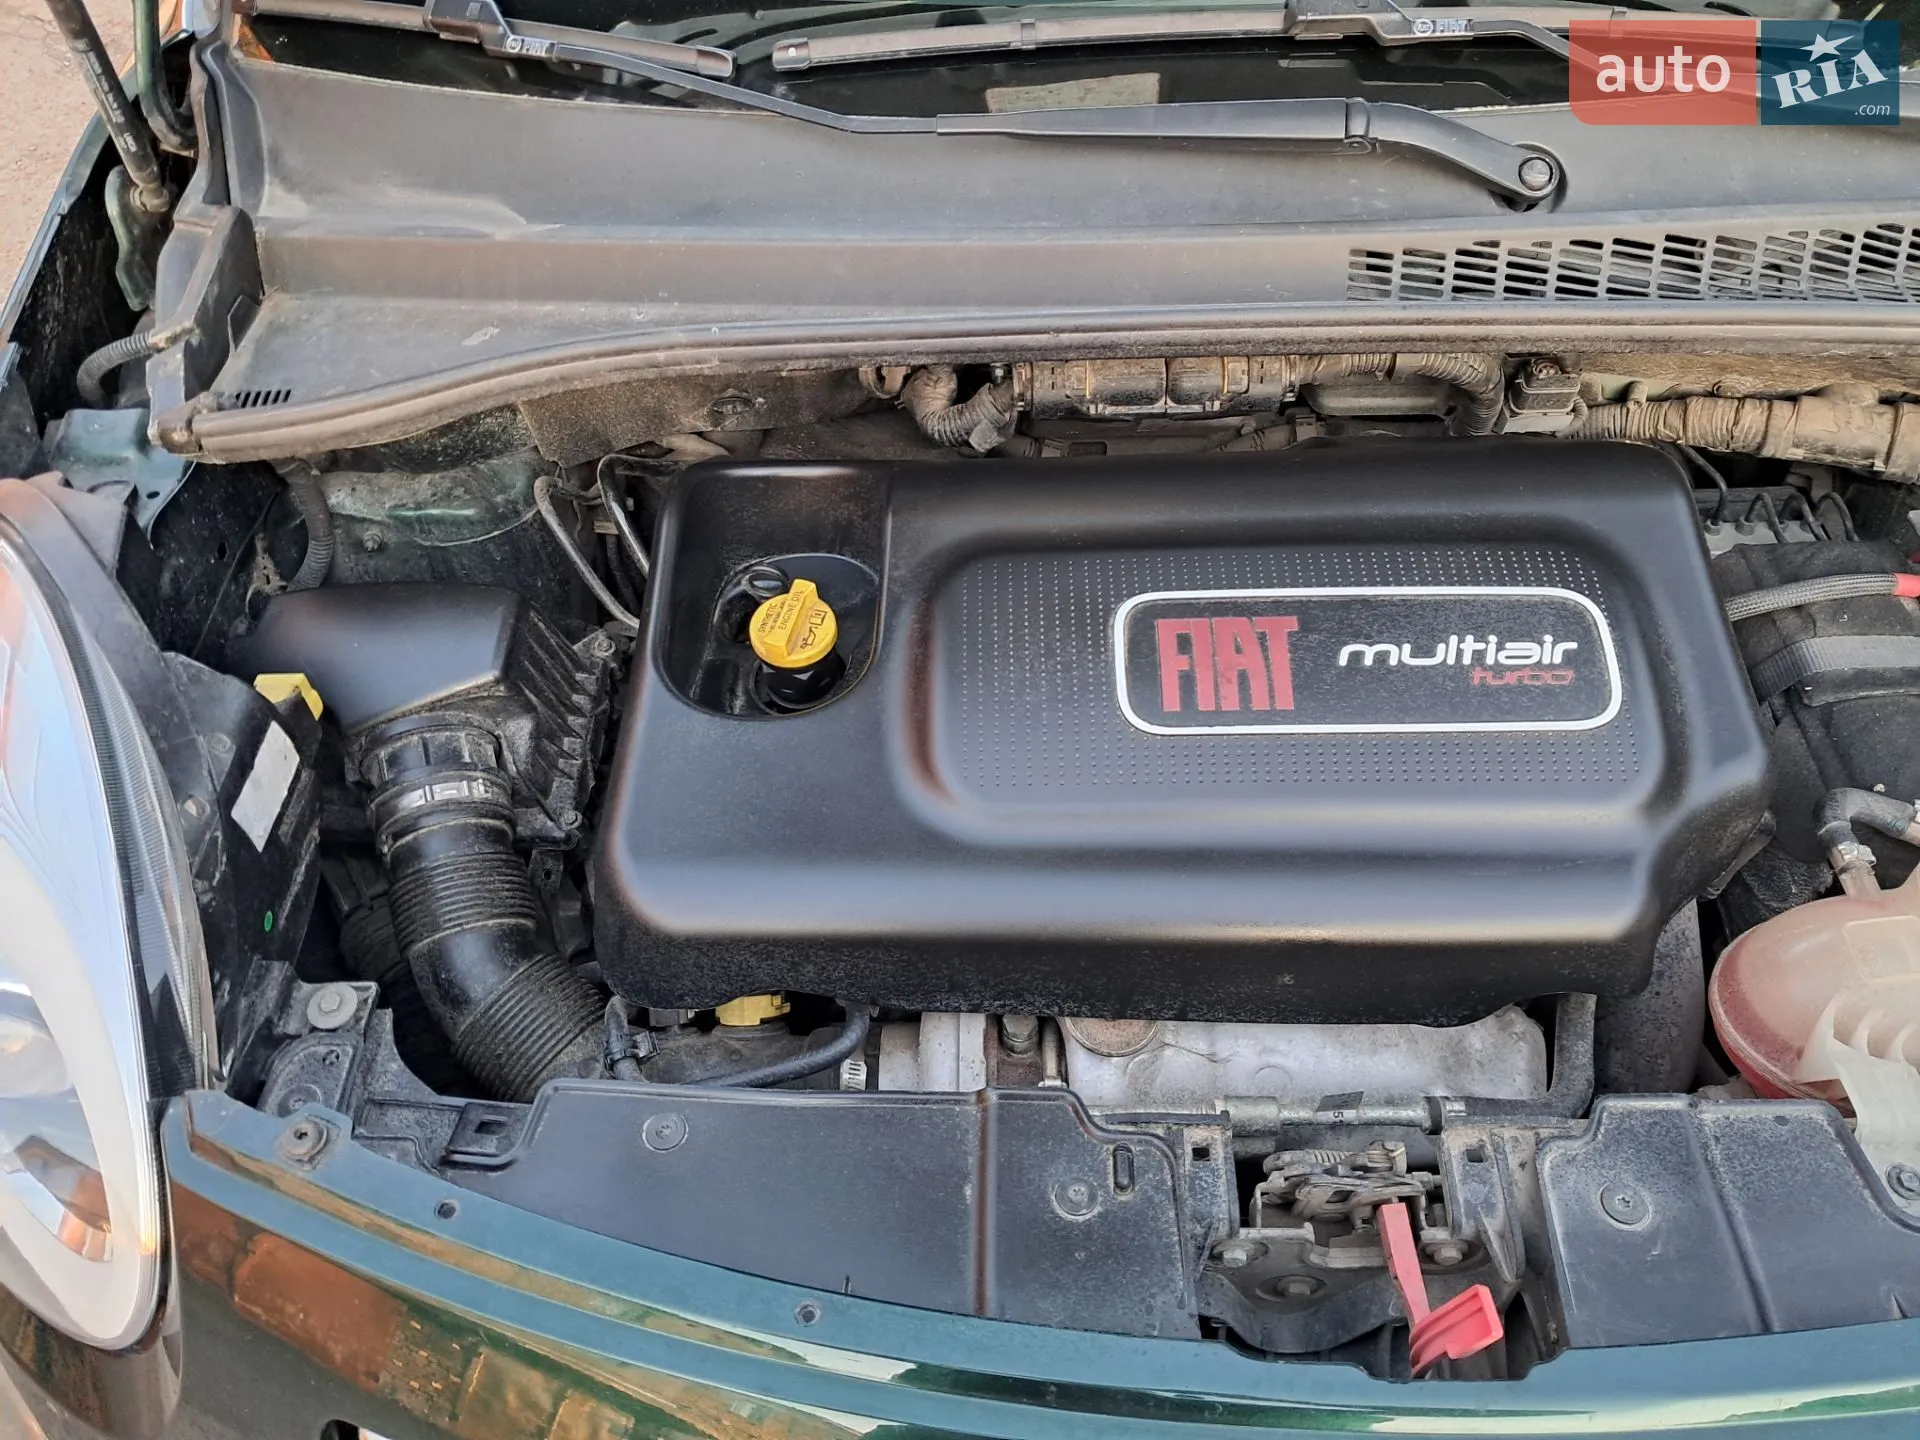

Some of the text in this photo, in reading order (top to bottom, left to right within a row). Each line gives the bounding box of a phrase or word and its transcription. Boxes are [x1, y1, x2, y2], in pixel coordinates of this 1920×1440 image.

[757, 601, 778, 633] SYNTHETIC
[777, 603, 797, 631] ENGINE
[791, 590, 805, 602] OIL
[1156, 616, 1299, 713] FIAT
[1338, 634, 1578, 666] multiair
[1470, 666, 1575, 686] turbo
